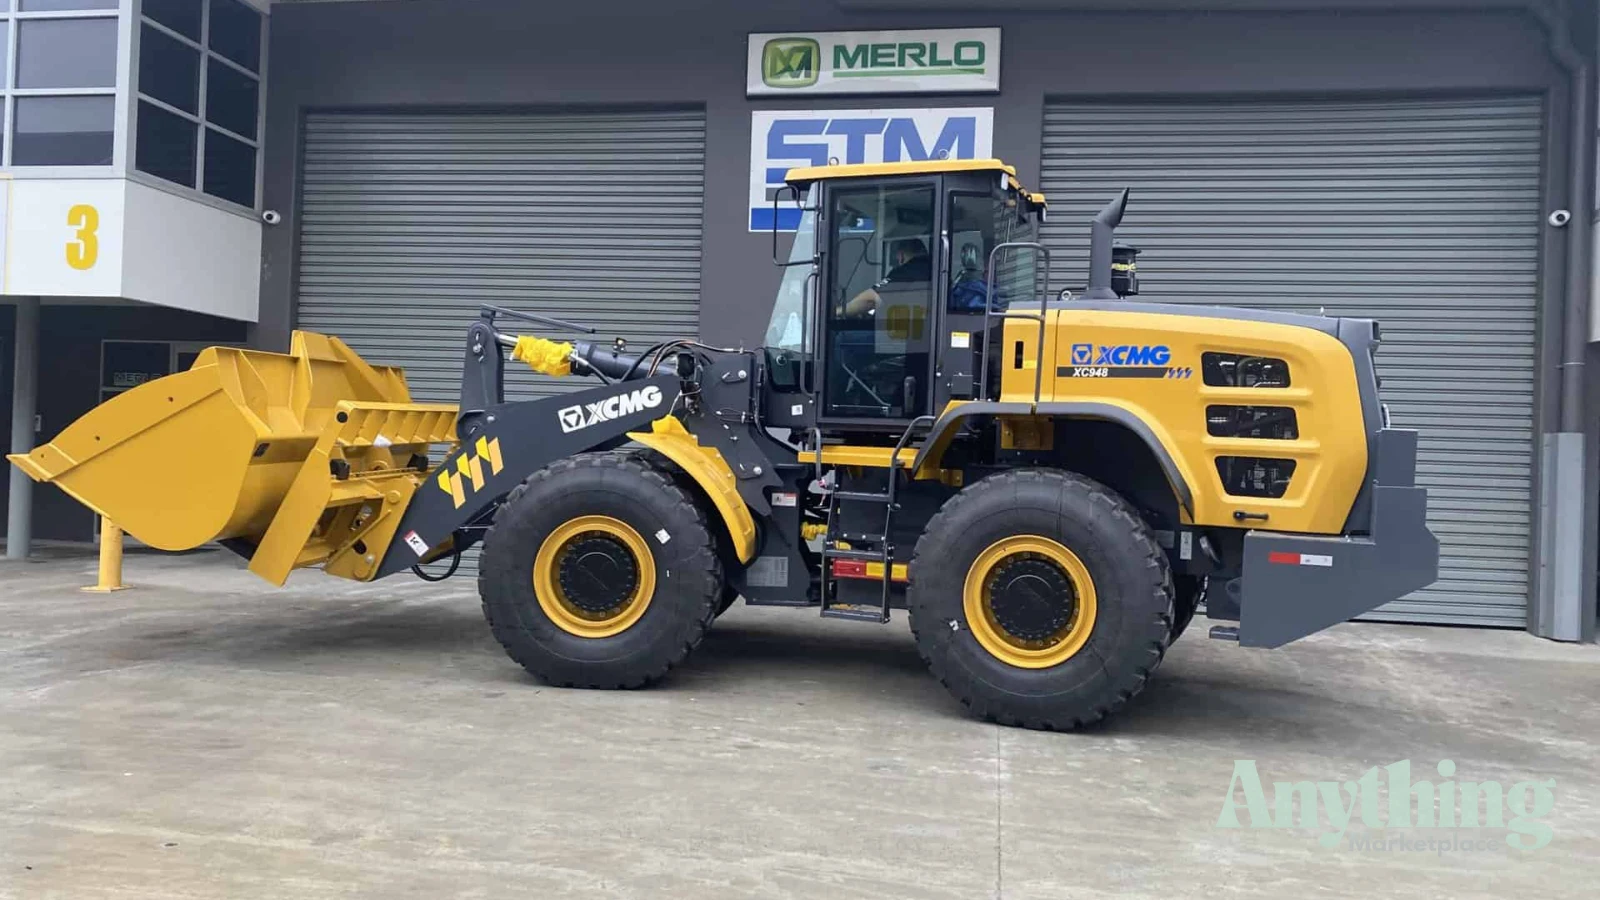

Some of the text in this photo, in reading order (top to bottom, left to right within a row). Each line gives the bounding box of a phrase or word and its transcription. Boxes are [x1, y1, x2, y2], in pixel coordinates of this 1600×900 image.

[833, 40, 986, 70] MERLO
[766, 116, 977, 184] STM
[65, 204, 99, 271] 3
[1072, 367, 1109, 377] XC948
[1093, 345, 1171, 366] XCMG
[585, 385, 663, 426] XCMG
